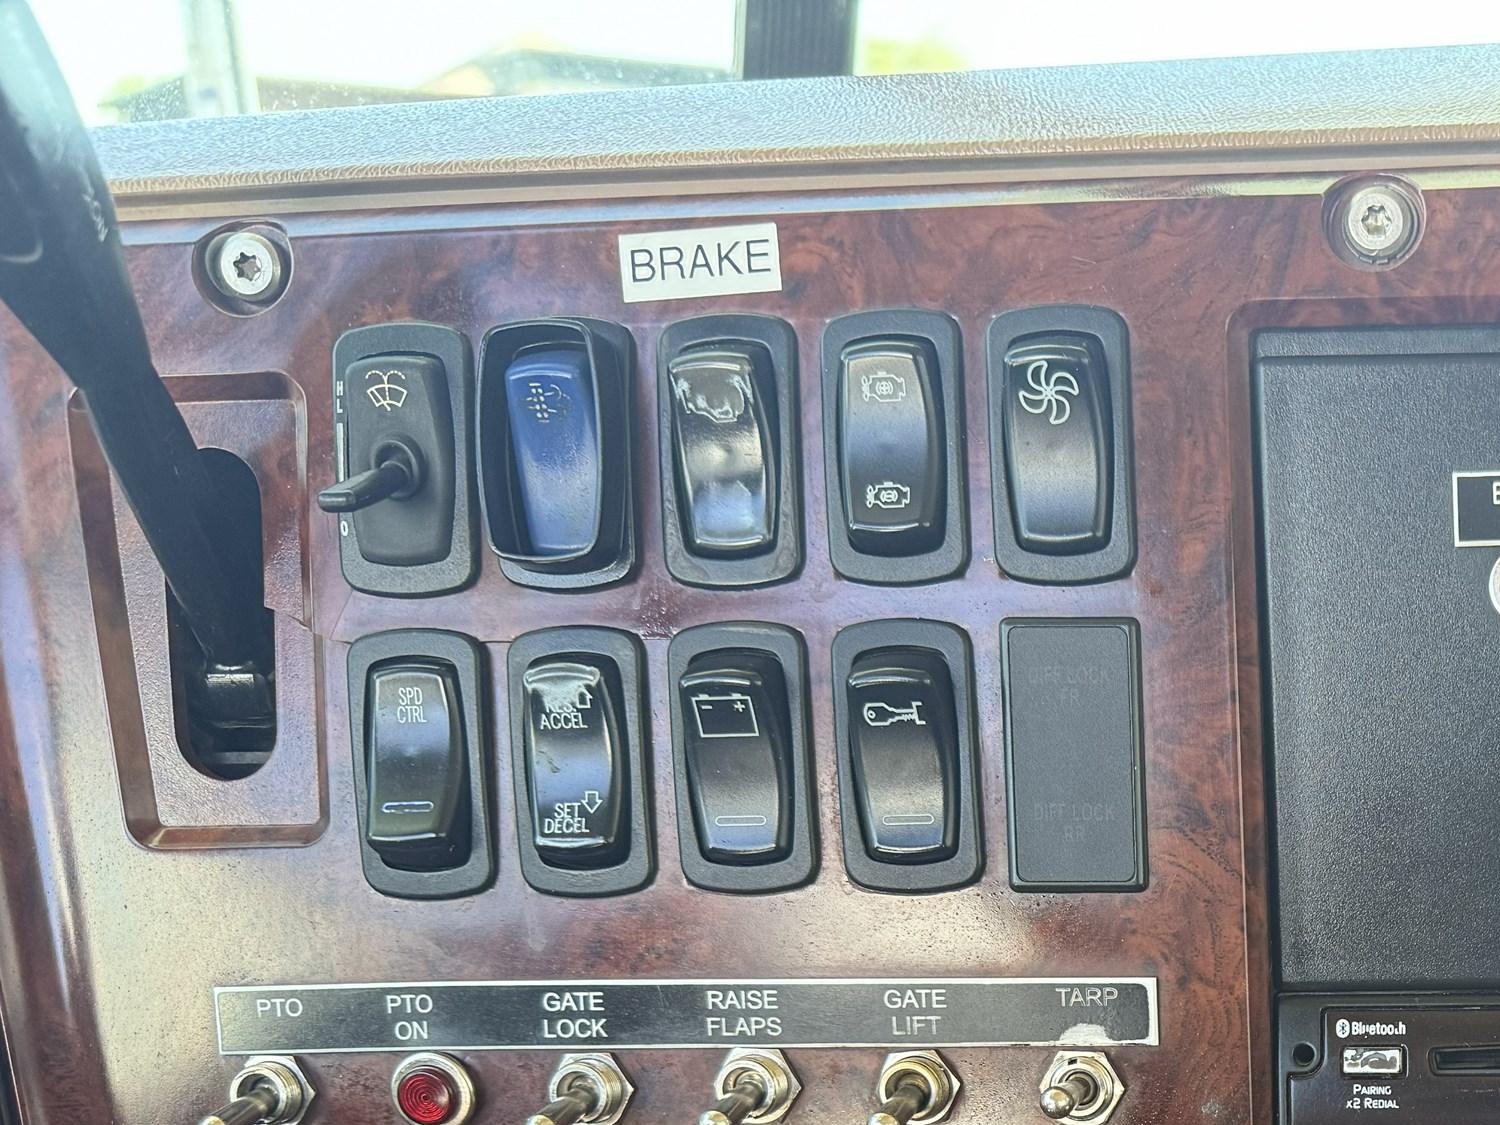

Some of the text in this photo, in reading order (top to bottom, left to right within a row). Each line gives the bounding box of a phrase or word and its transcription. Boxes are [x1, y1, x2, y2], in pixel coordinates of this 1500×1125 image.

[630, 239, 772, 283] BRAKE
[336, 381, 344, 396] H
[336, 398, 344, 414] L
[398, 687, 423, 705] SPD
[397, 706, 427, 723] CTRL
[540, 712, 588, 730] ACCEL
[554, 802, 581, 818] SET
[544, 818, 590, 834] DECEL
[386, 994, 433, 1014] PTO
[542, 992, 605, 1012] GATE
[707, 990, 778, 1010] RAISE
[884, 989, 947, 1009] GATE
[1056, 987, 1118, 1007] TARP
[256, 999, 303, 1018] PTO
[394, 1021, 428, 1040] ON
[543, 1018, 607, 1039] LOCK
[707, 1016, 783, 1037] FLAPS
[892, 1016, 941, 1036] LIFT
